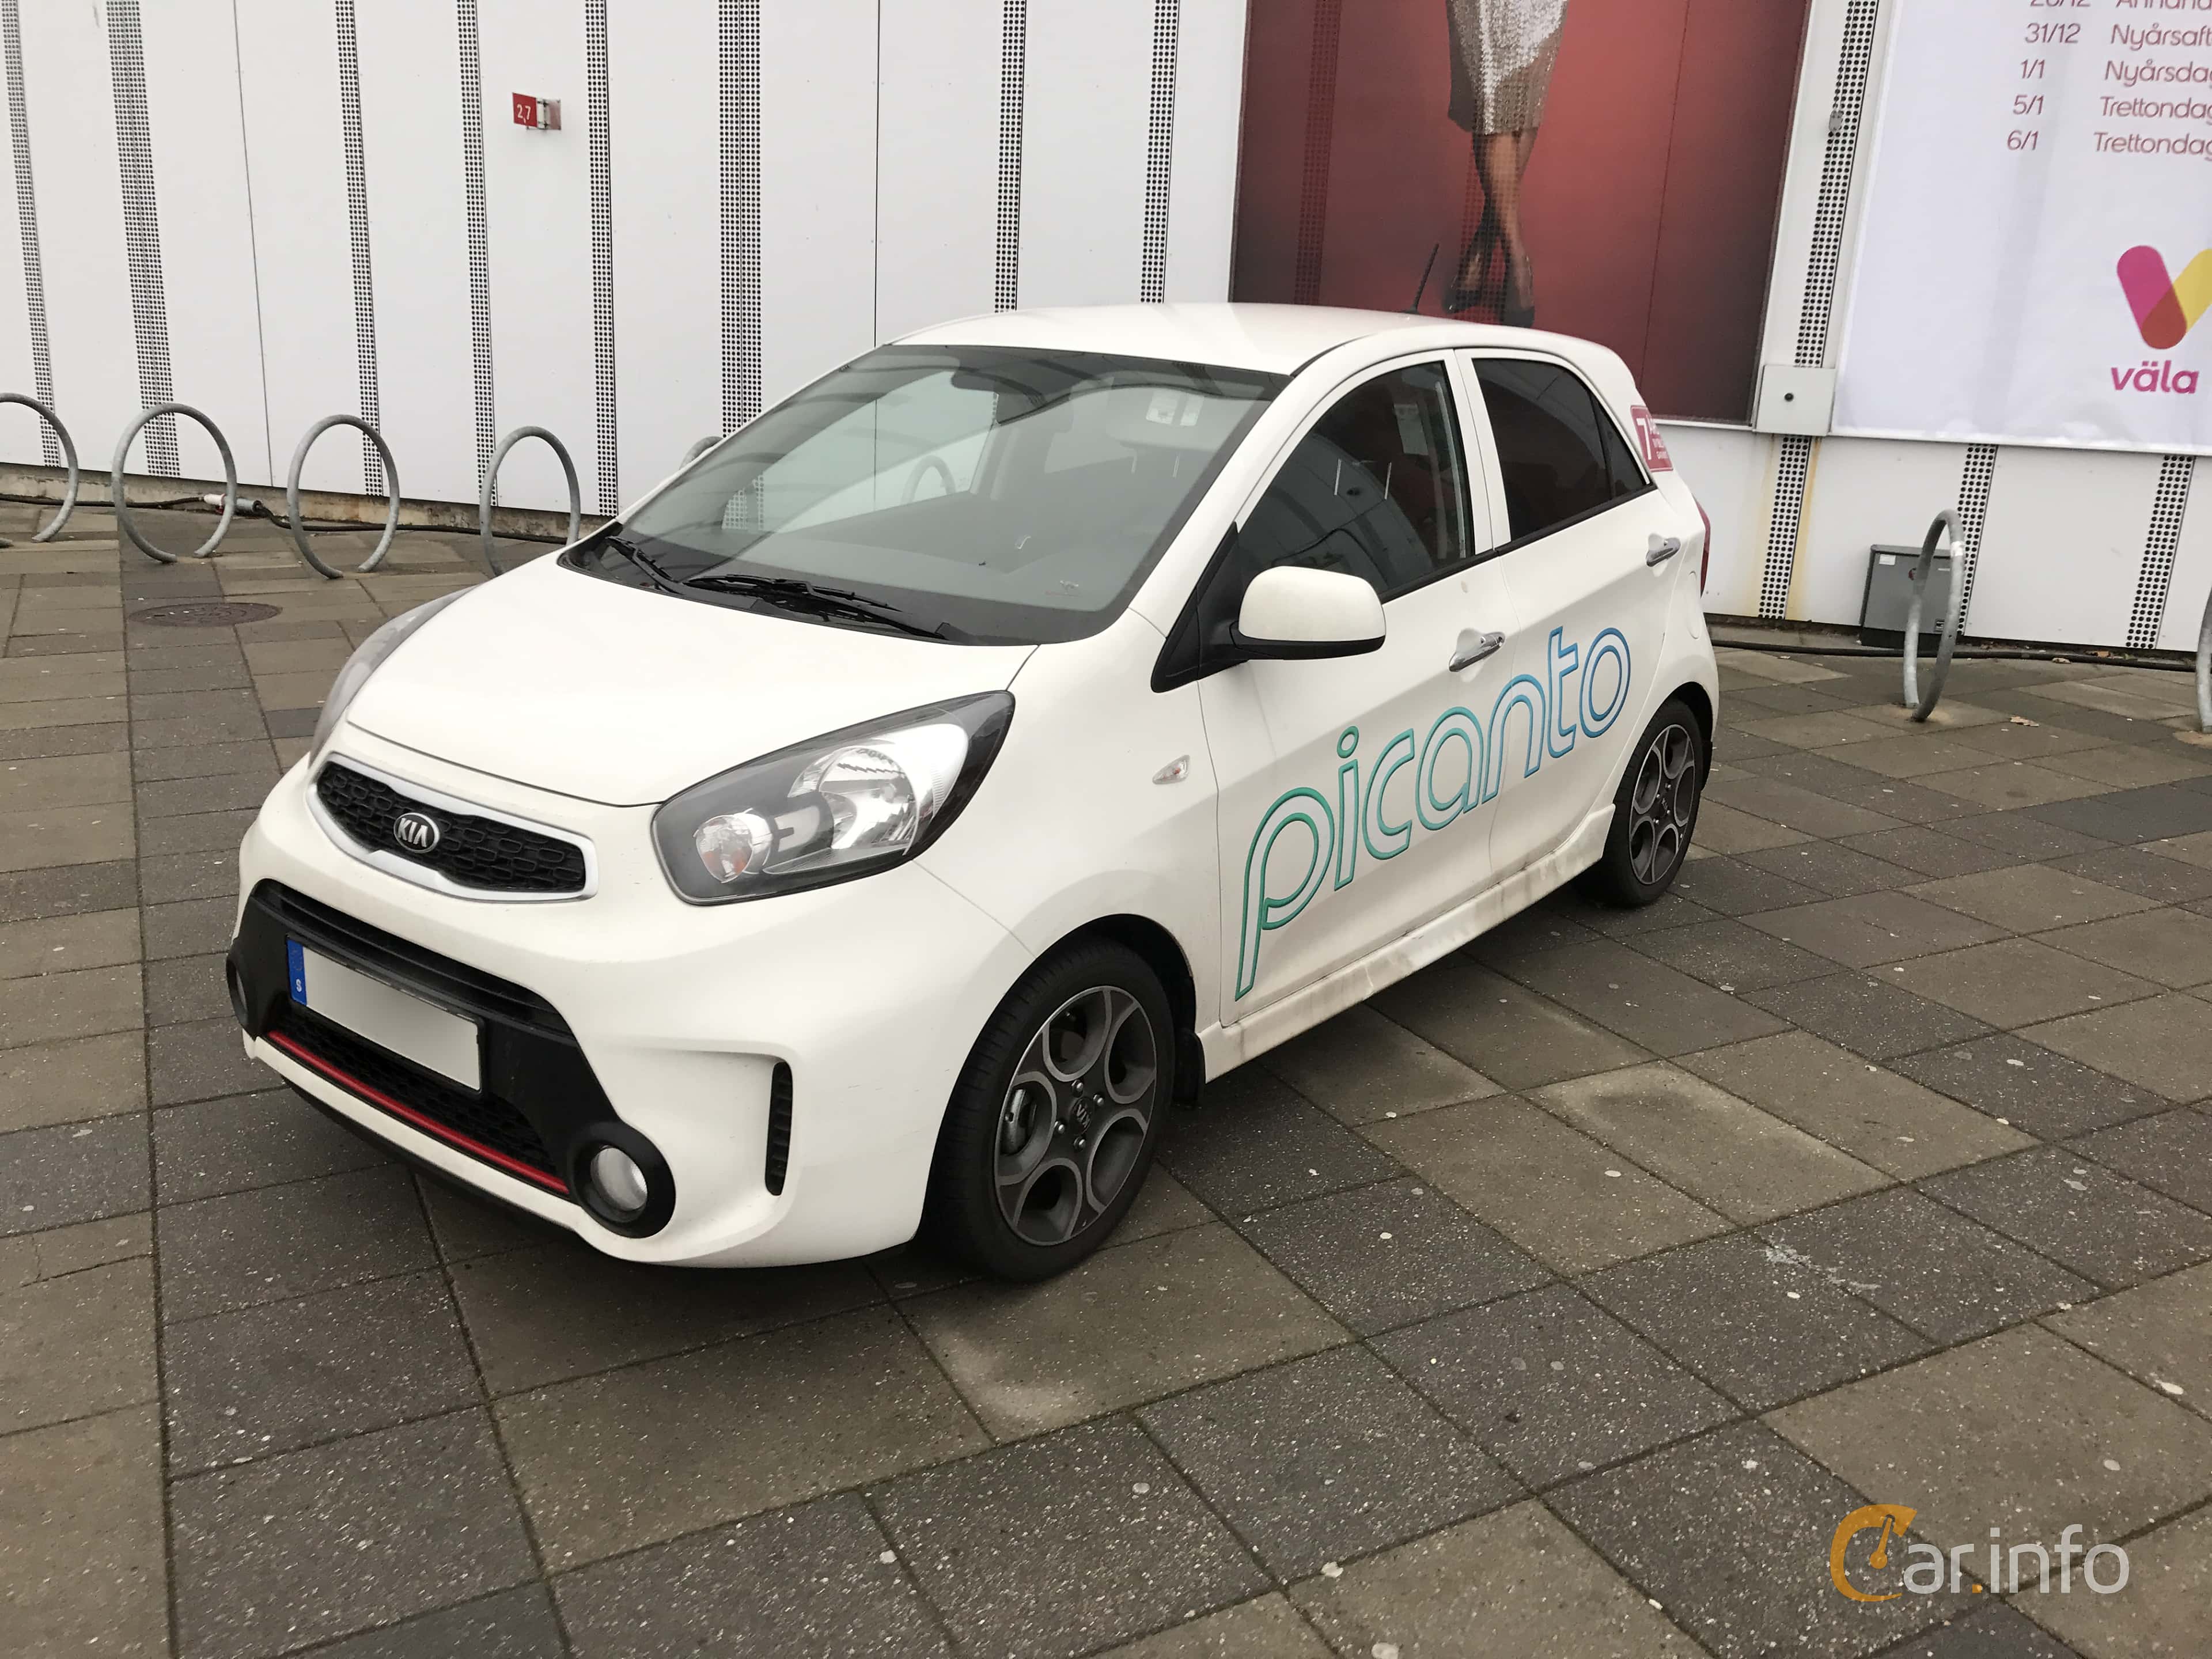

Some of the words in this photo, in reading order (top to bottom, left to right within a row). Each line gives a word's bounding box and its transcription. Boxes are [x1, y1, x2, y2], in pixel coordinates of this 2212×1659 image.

[2025, 22, 2081, 43] 31/12
[2020, 59, 2045, 79] 1/1
[2105, 59, 2212, 87] Nyårsda
[2013, 94, 2044, 115] 5/1
[2007, 130, 2039, 150] 6/1
[2111, 359, 2199, 395] väla
[1235, 626, 1631, 1001] picanto
[397, 818, 428, 847] KIA
[296, 979, 302, 993] S
